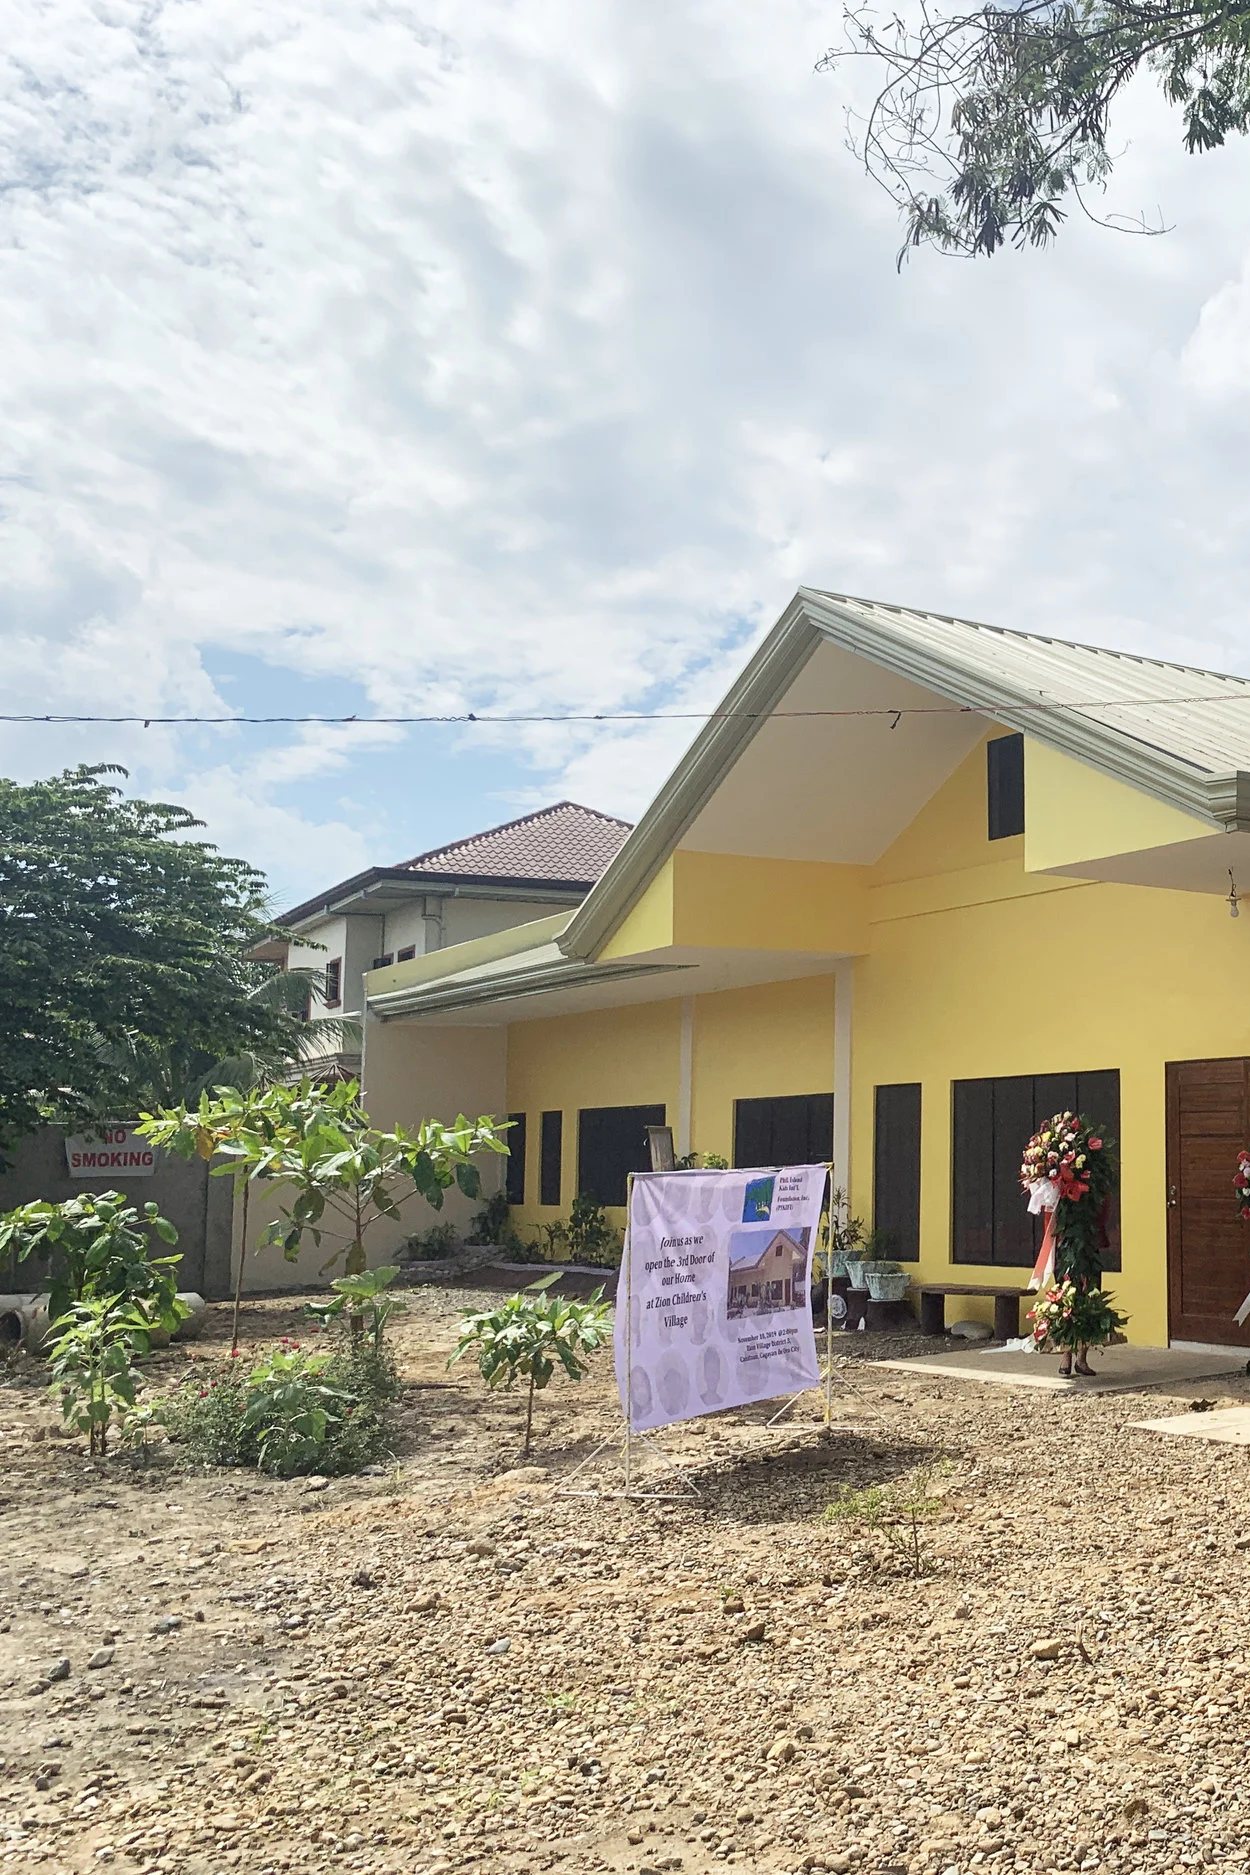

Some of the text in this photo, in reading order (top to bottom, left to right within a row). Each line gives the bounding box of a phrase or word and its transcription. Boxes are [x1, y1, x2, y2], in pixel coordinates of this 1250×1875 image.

[103, 1129, 127, 1144] NO
[71, 1152, 154, 1168] SMOKING
[684, 1237, 692, 1245] as
[694, 1236, 704, 1244] we
[645, 1252, 715, 1273] open the 3rd Door of
[662, 1273, 695, 1286] our Home
[646, 1290, 706, 1310] at Zion Children's
[664, 1315, 688, 1328] Village
